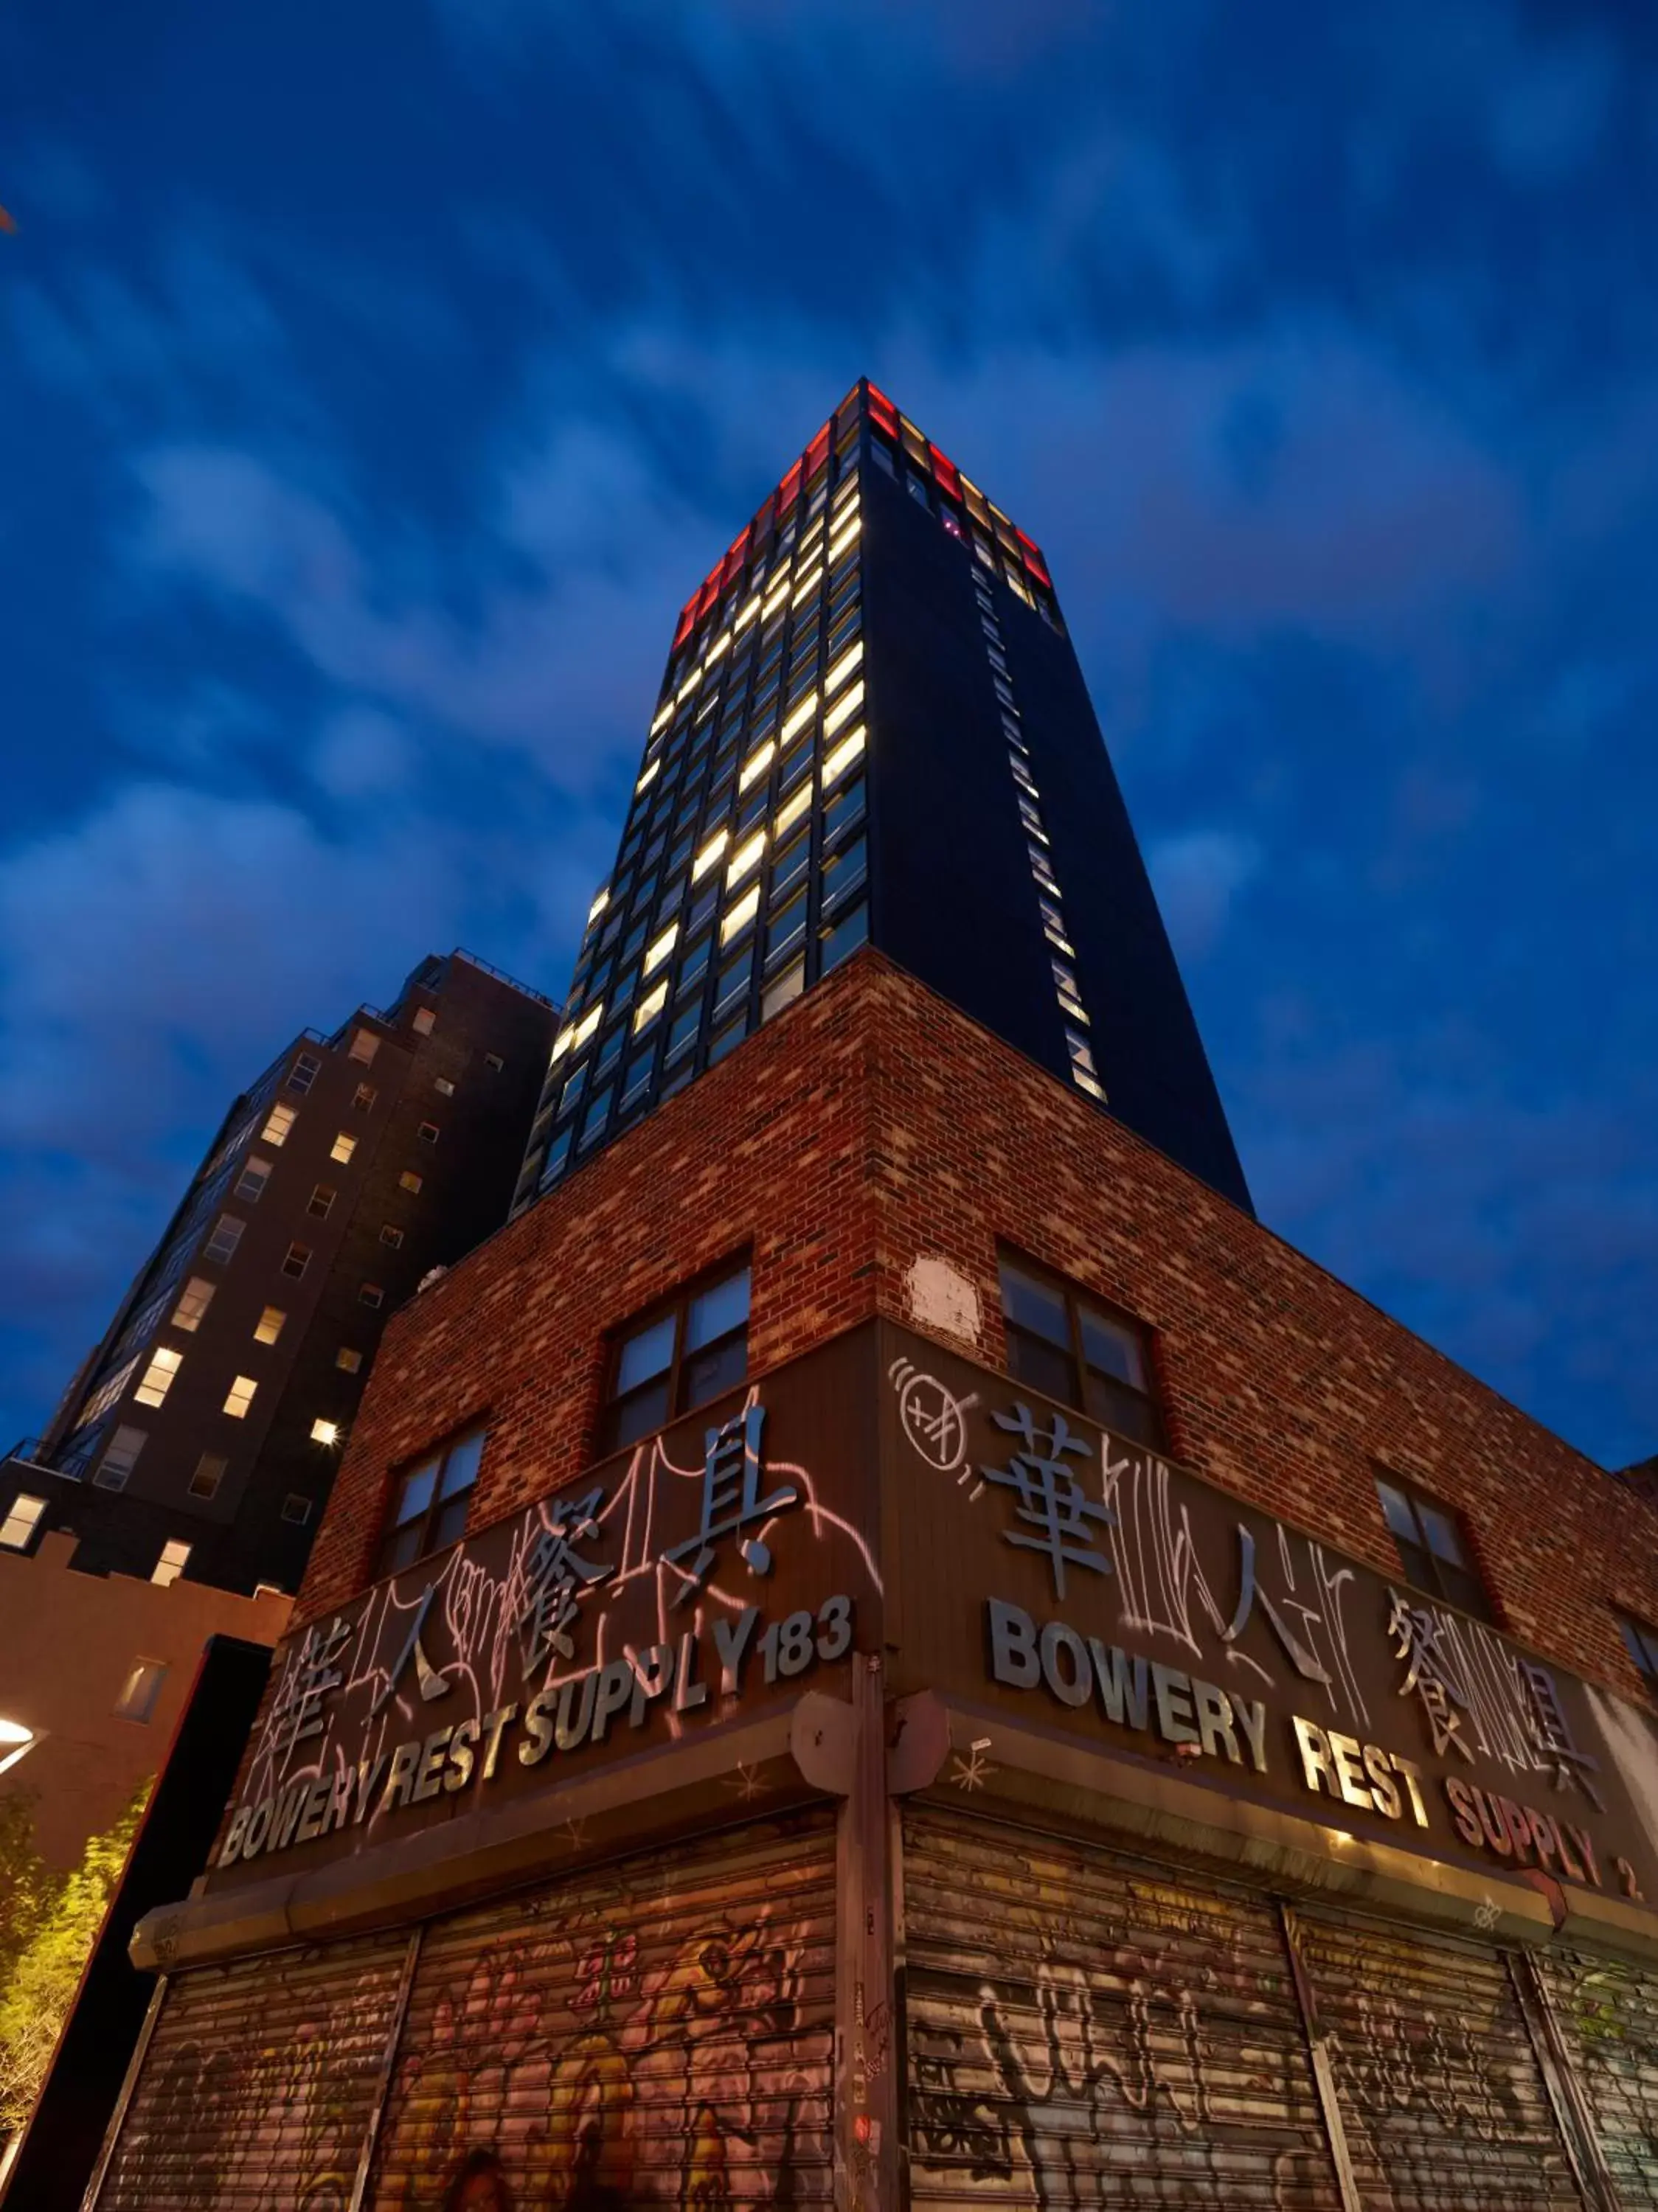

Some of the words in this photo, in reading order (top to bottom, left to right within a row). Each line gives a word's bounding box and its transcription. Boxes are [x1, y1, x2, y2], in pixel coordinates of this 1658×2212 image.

[218, 1753, 386, 1868] BOWERY
[385, 1702, 518, 1812] REST
[518, 1606, 760, 1767] SUPPLY
[757, 1593, 853, 1685] 183
[986, 1597, 1267, 1773] BOWERY
[1291, 1715, 1429, 1829] REST
[1445, 1775, 1602, 1888] SUPPLY
